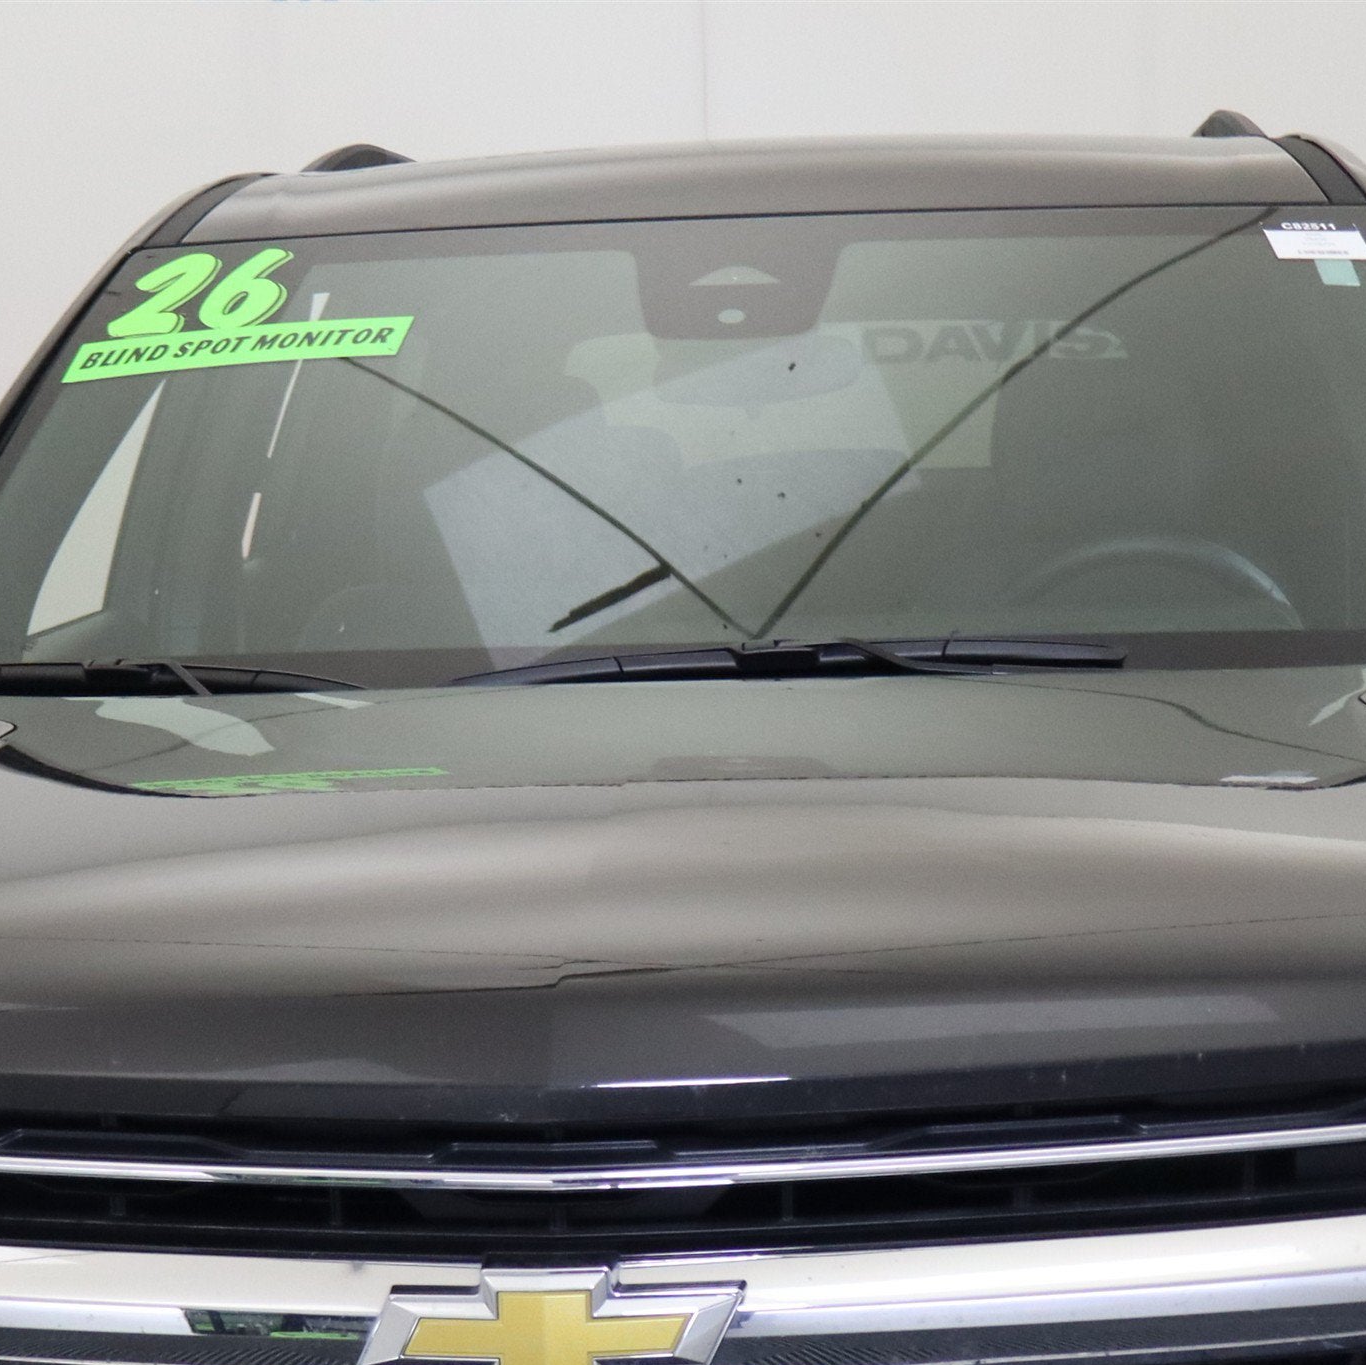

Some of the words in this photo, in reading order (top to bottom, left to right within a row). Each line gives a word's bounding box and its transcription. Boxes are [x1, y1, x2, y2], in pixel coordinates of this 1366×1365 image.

[107, 248, 294, 338] 26
[79, 344, 169, 370] BLIND
[173, 335, 252, 358] SPOT
[250, 327, 395, 351] MONITOR
